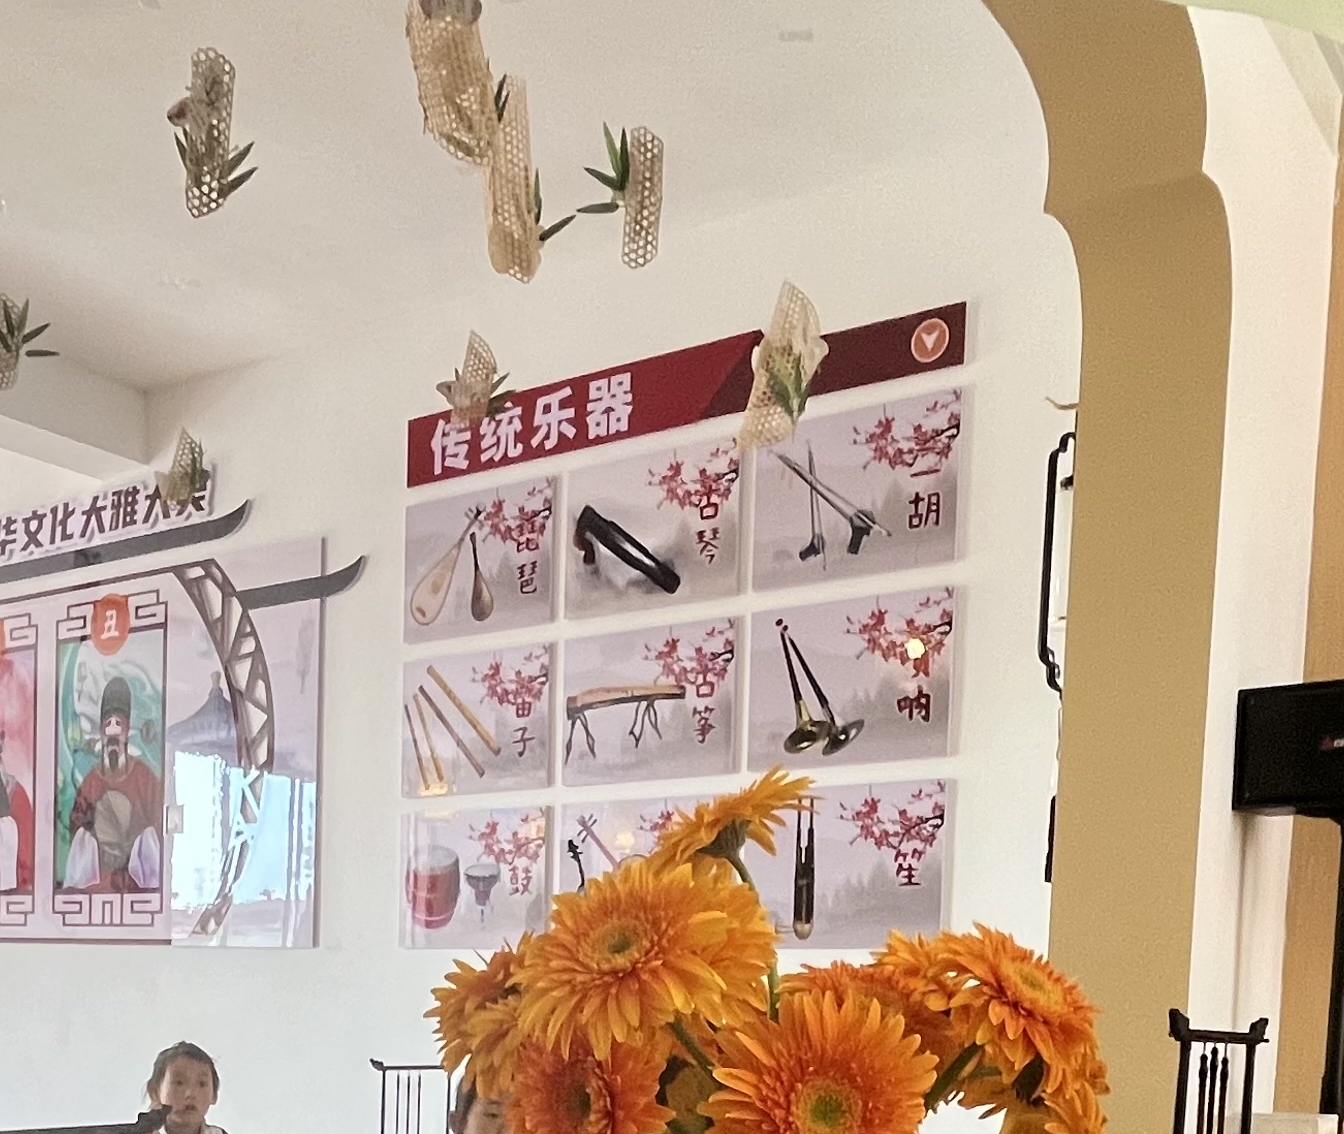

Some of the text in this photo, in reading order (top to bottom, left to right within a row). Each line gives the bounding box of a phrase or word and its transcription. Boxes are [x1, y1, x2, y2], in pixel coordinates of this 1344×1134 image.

[430, 371, 633, 475] 传统乐器
[101, 609, 119, 640] 丑
[893, 847, 922, 887] 笙
